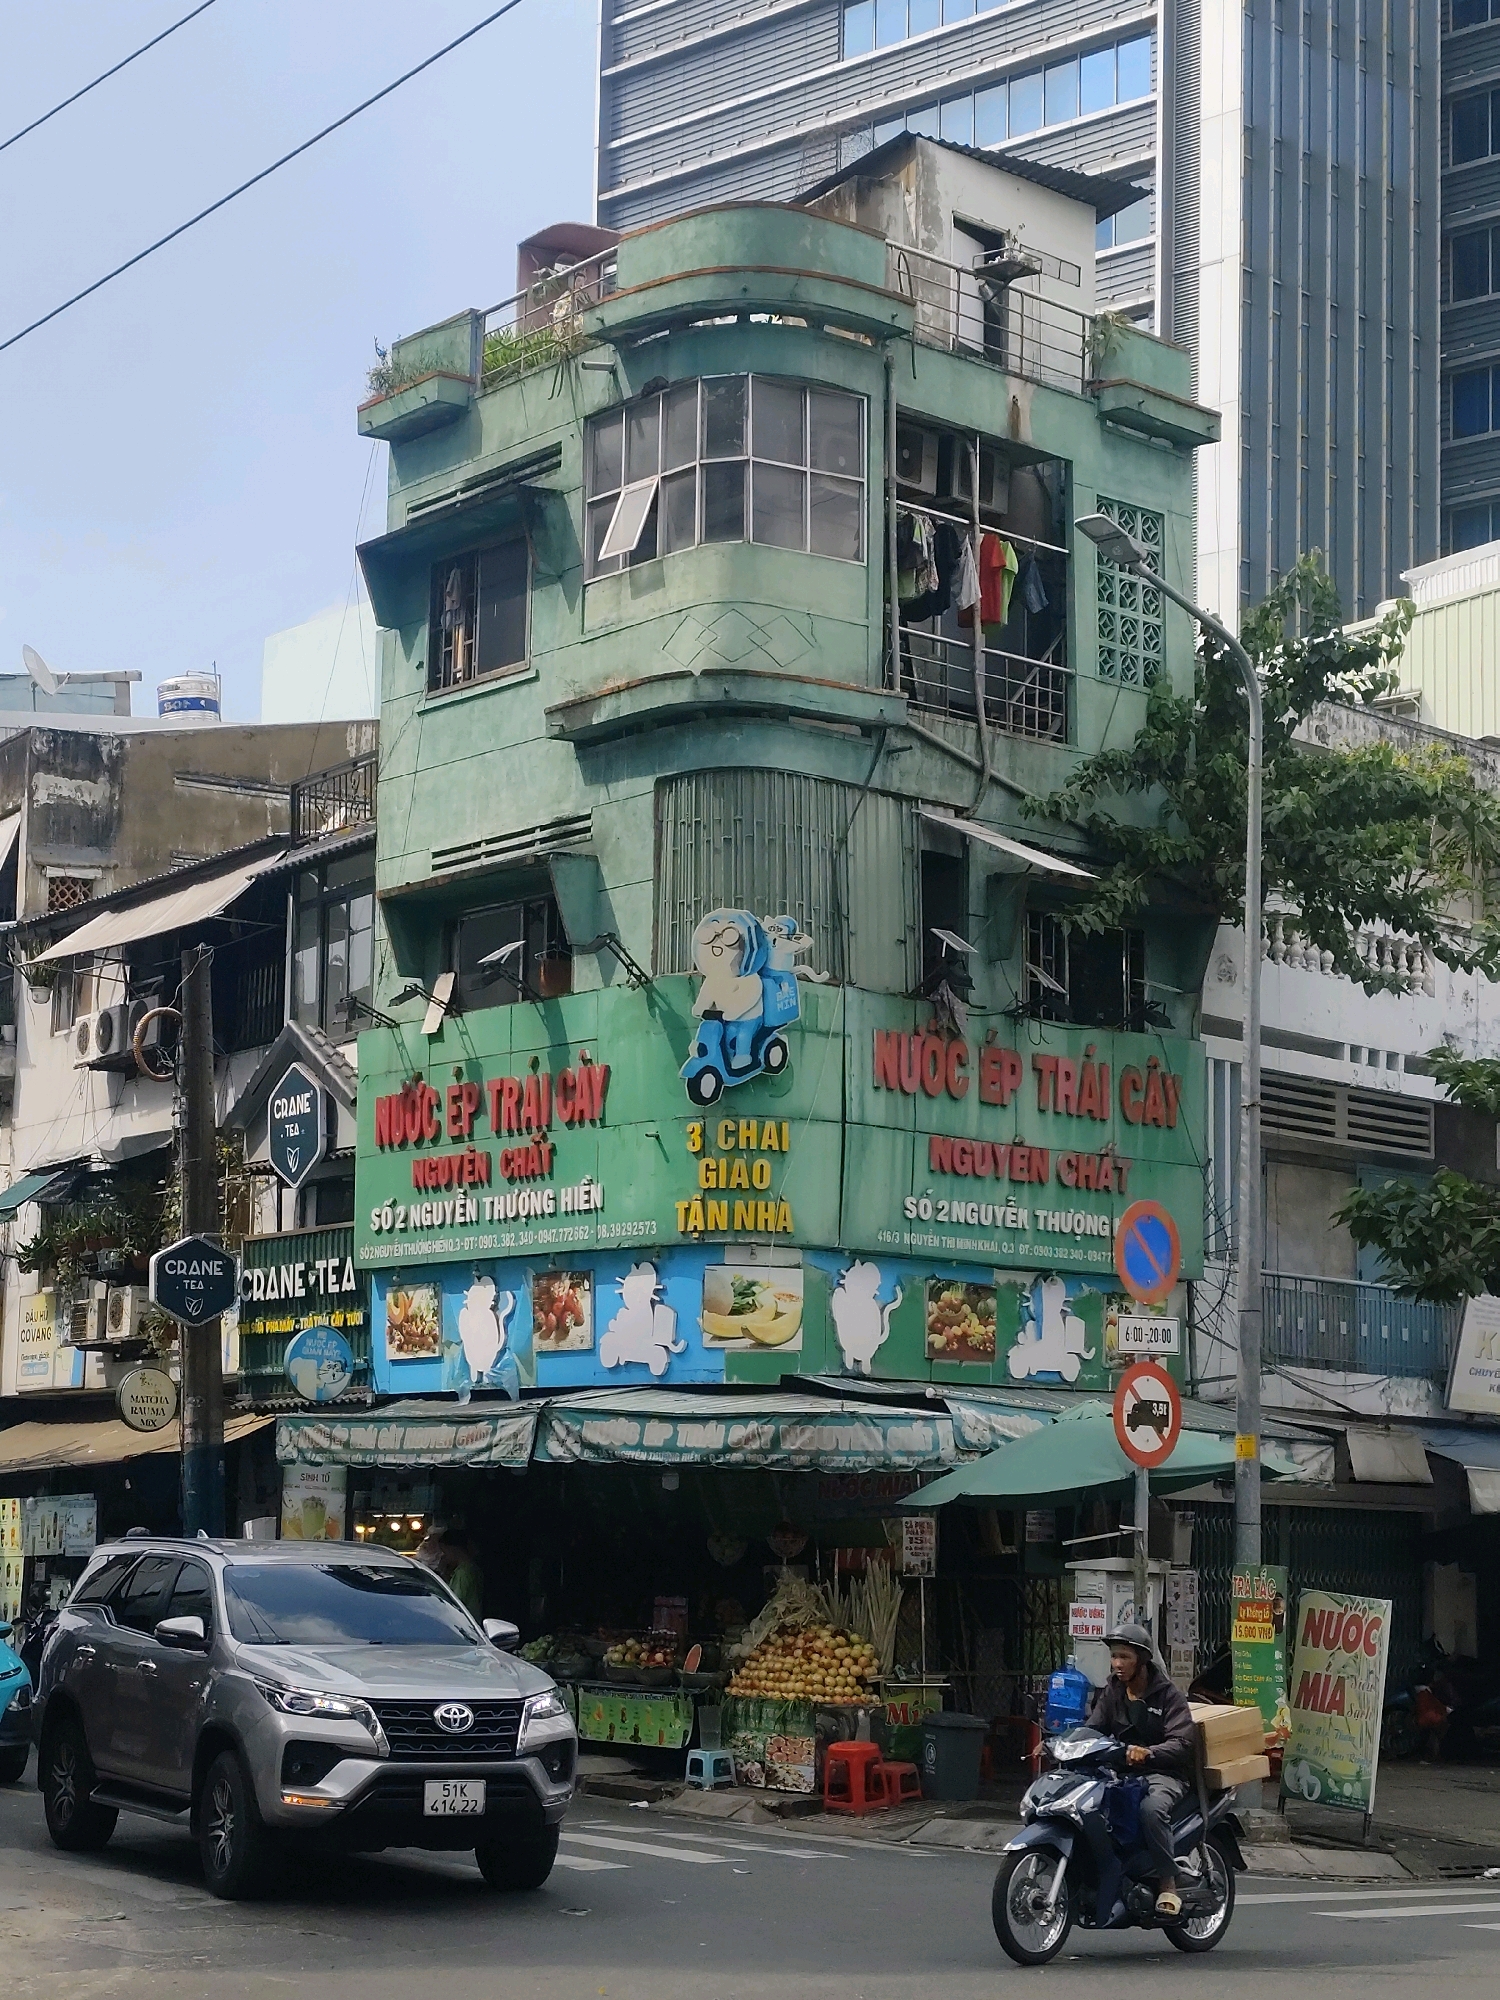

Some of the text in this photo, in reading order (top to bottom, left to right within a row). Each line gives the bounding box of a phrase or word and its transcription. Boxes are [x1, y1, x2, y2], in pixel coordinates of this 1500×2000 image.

[874, 1019, 1183, 1128] NƯỚC ÉP TRÁI CÂY
[274, 1093, 311, 1120] CRANE
[375, 1049, 611, 1147] NƯỚC ÉP TRÁI CÂY
[284, 1123, 300, 1137] TEA
[686, 1119, 790, 1153] 3 CHAI
[412, 1132, 556, 1189] NGUYÊN CHẤT
[699, 1157, 771, 1190] GIAO
[929, 1134, 1133, 1194] NGUYÊN CHẤT
[370, 1198, 396, 1231] SỐ
[395, 1205, 408, 1229] 2
[410, 1188, 480, 1228] NGUYỄN
[482, 1188, 555, 1226] THƯỢNG
[675, 1194, 794, 1239] TẬN NHÀ
[903, 1188, 934, 1222] SỐ
[935, 1200, 950, 1222] 2
[951, 1195, 1029, 1230] NGUYỄN
[1034, 1208, 1110, 1242] THƯỢNG
[165, 1259, 224, 1276] CRANE
[183, 1279, 204, 1290] TEA
[240, 1257, 356, 1302] CRANE TEA
[130, 1395, 169, 1404] MATCHA
[1233, 1568, 1277, 1600] TRÀ TẮC
[1301, 1601, 1383, 1657] NƯỚC
[1293, 1661, 1346, 1716] MÍA
[430, 1799, 478, 1813] 414.22
[442, 1784, 468, 1798] 51K
